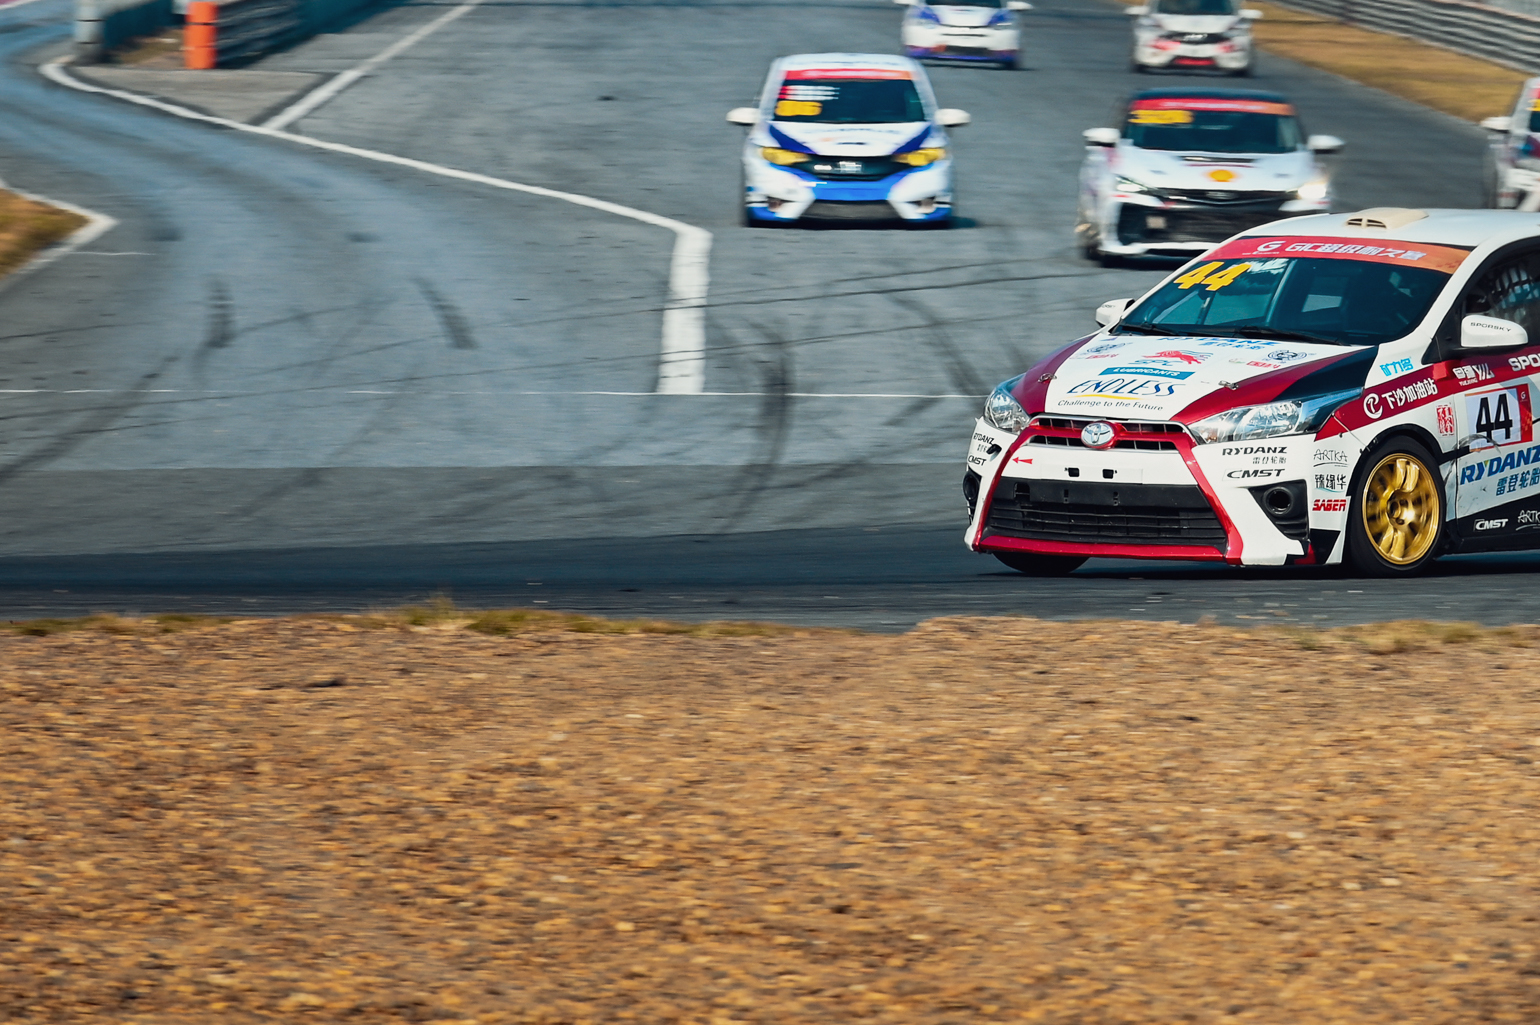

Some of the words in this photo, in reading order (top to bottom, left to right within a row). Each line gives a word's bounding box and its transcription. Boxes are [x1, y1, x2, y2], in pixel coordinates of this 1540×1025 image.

[1173, 261, 1253, 291] 44
[1470, 322, 1511, 332] SPORSKY
[1113, 367, 1180, 376] LUBRICANTS
[1066, 378, 1186, 397] ENDLESS
[1381, 378, 1438, 410] 下沙加油站
[1057, 399, 1101, 408] Challenge
[1115, 400, 1131, 408] the
[1133, 402, 1164, 411] Future
[1475, 393, 1513, 443] 44
[1222, 446, 1288, 456] RYDANZ
[1226, 468, 1286, 479] CMST
[1312, 498, 1347, 512] SABER
[1475, 518, 1509, 531] CMST
